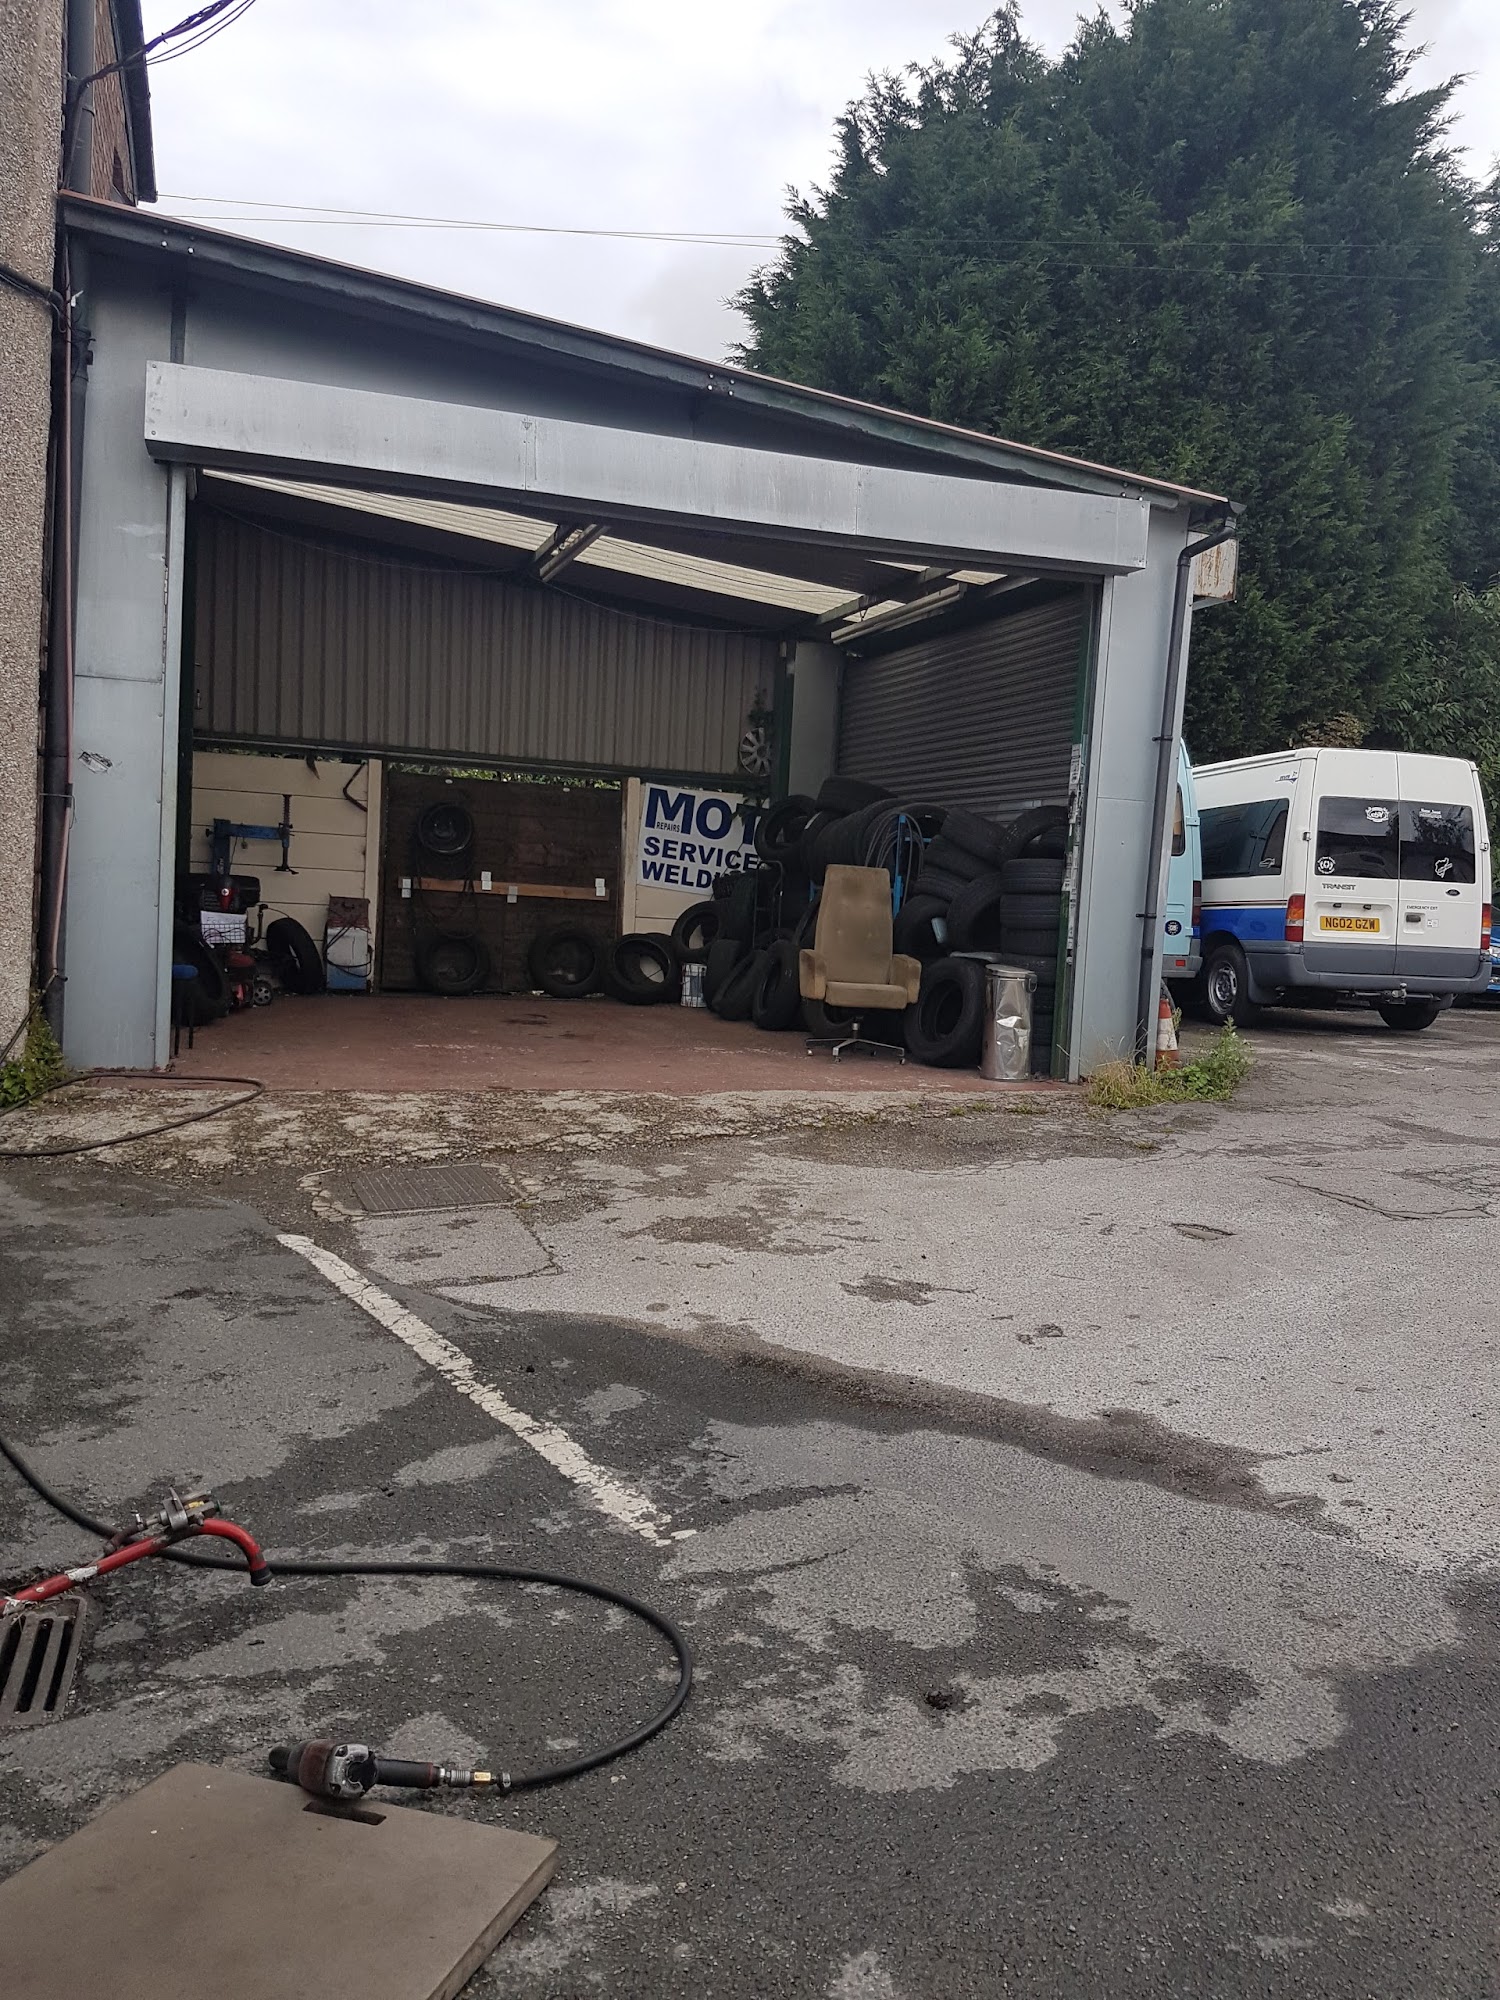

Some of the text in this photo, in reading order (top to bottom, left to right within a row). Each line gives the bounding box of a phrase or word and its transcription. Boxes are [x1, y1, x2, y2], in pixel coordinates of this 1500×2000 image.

[645, 787, 767, 845] MOT
[656, 821, 680, 833] REPAIRS
[644, 836, 760, 871] SERVICE
[1322, 883, 1357, 891] TRANSIT
[1325, 917, 1375, 930] NG02 GZW
